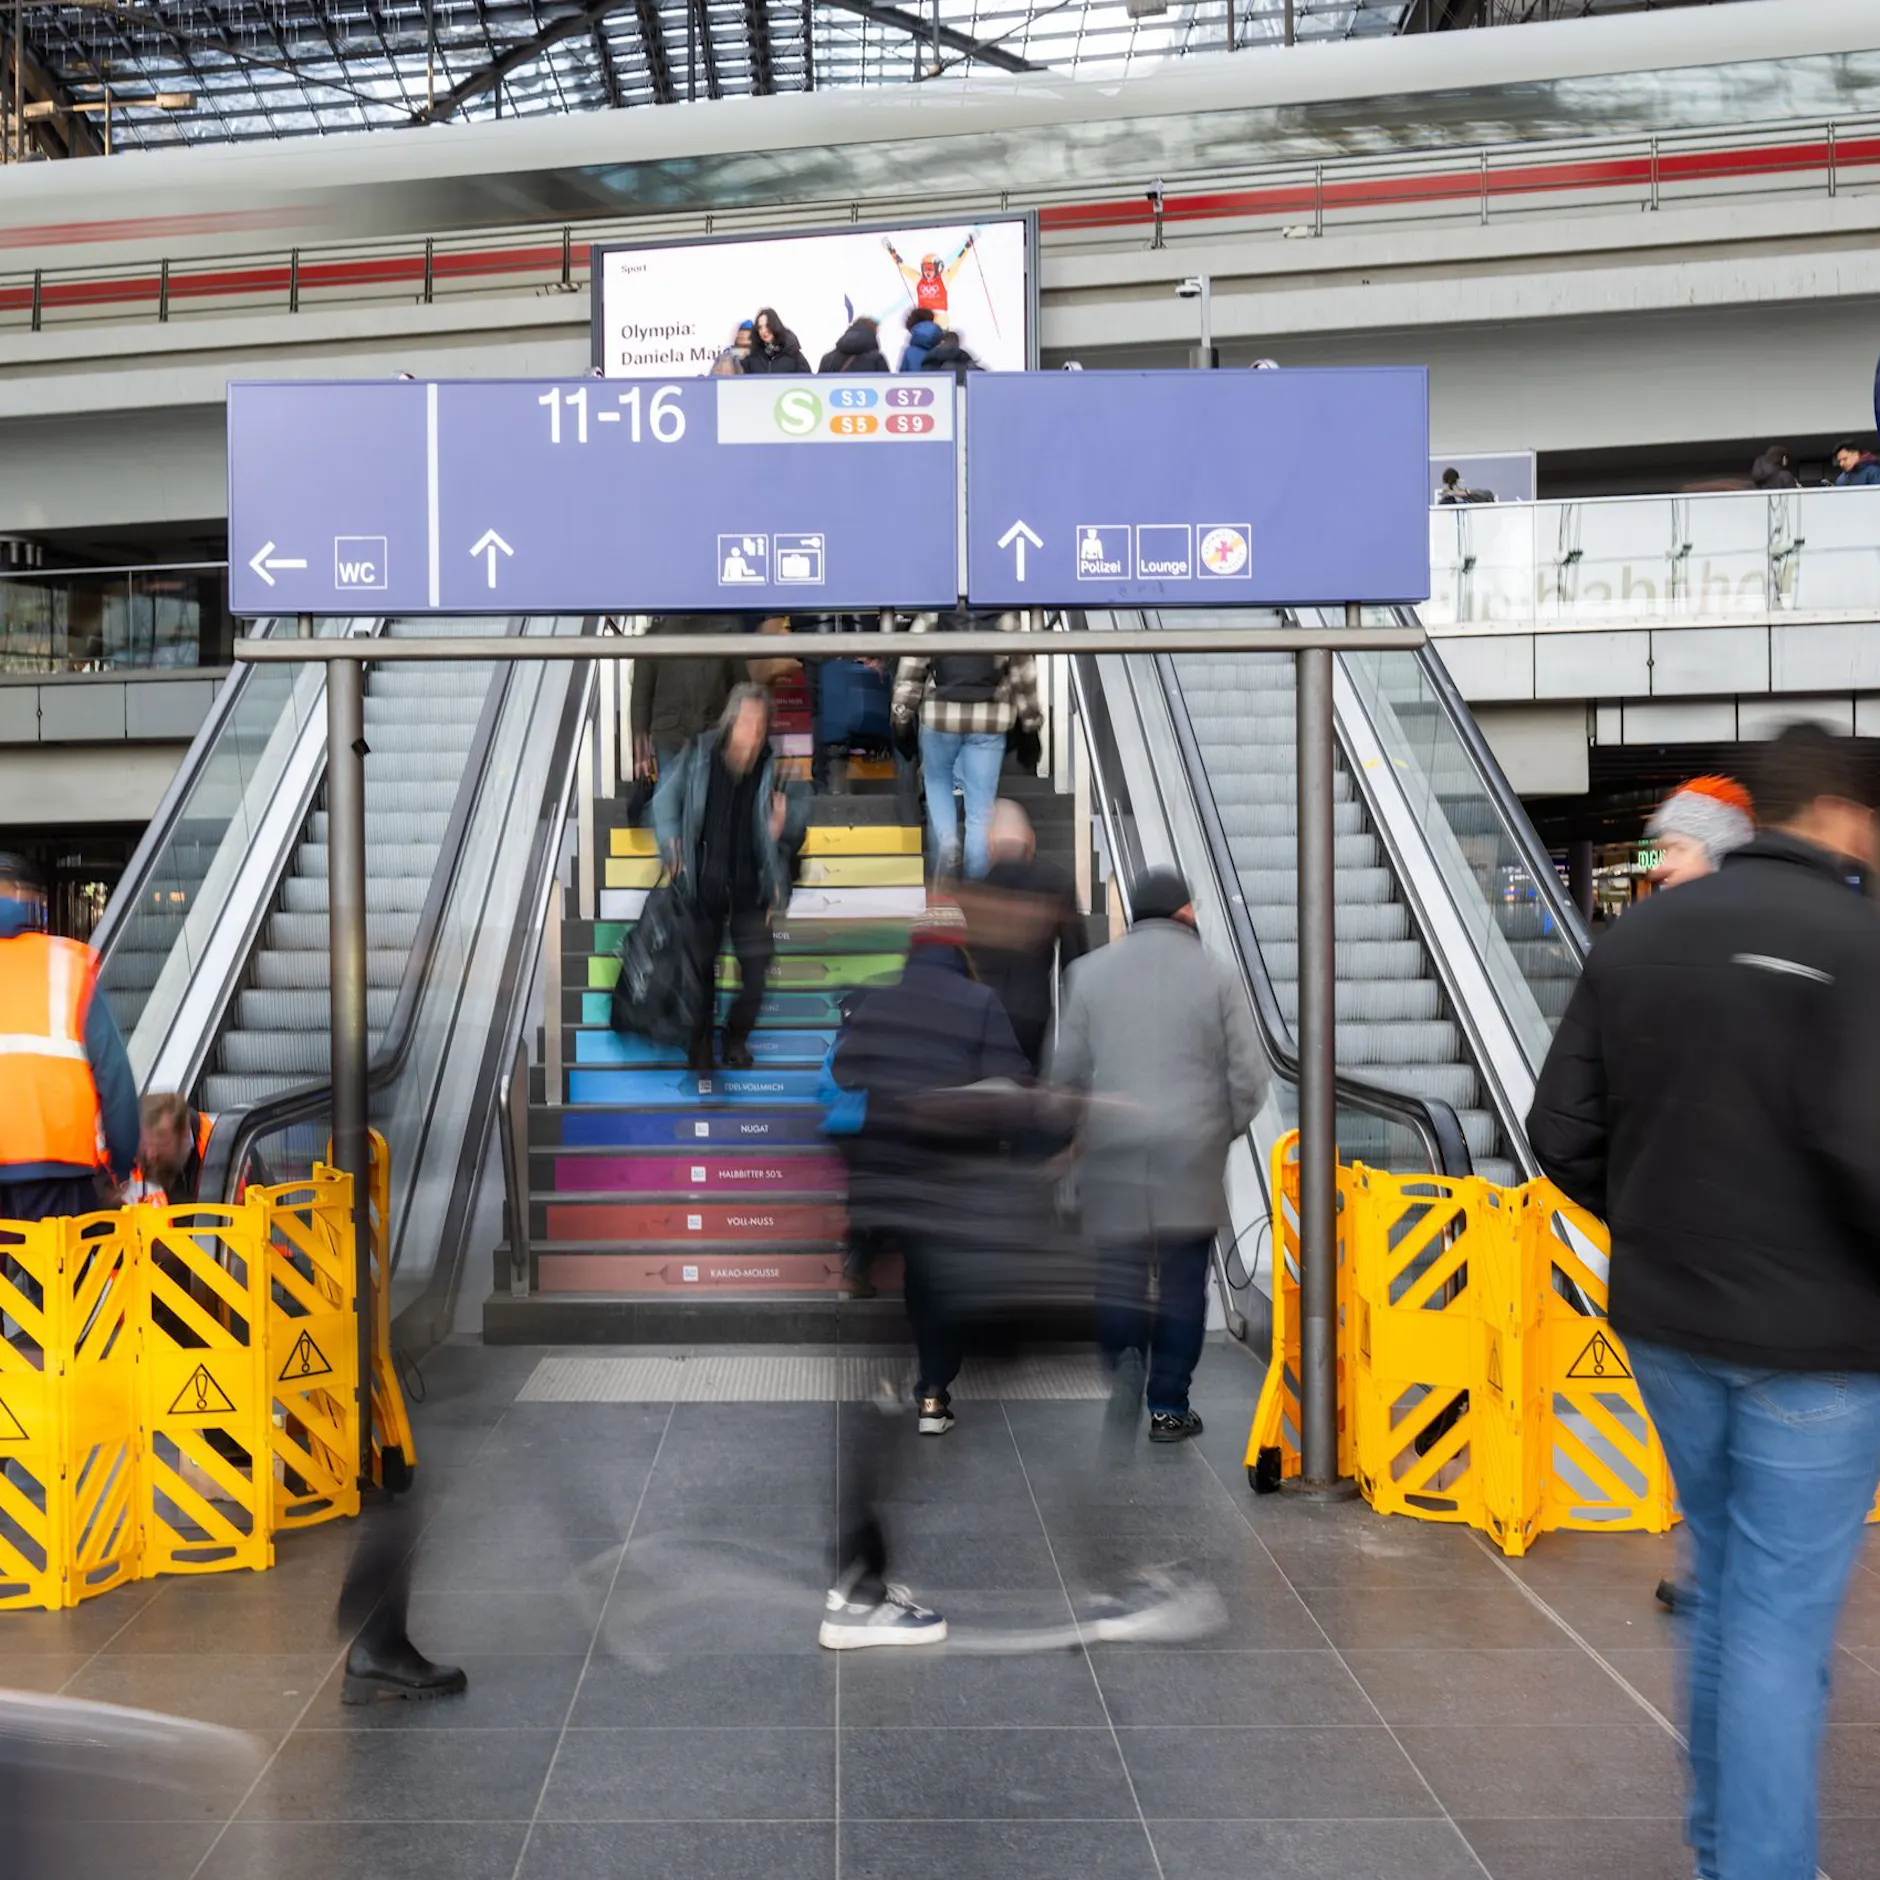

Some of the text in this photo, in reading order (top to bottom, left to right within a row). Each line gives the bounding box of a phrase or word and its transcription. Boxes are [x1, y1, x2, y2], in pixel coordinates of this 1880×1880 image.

[621, 263, 647, 274] Sport
[621, 321, 696, 342] Olympia:
[621, 345, 725, 366] Daniela Mai
[538, 385, 687, 444] 11-16
[338, 561, 376, 584] WC
[1080, 560, 1121, 574] Polizei
[1140, 559, 1188, 576] Lounge
[740, 1124, 769, 1133] NUGAT
[718, 1169, 764, 1180] HALBBITTER
[765, 1169, 783, 1179] 50%
[726, 1216, 774, 1227] VOLL-NUSS
[709, 1268, 780, 1279] KAKAO-MOUSSE
